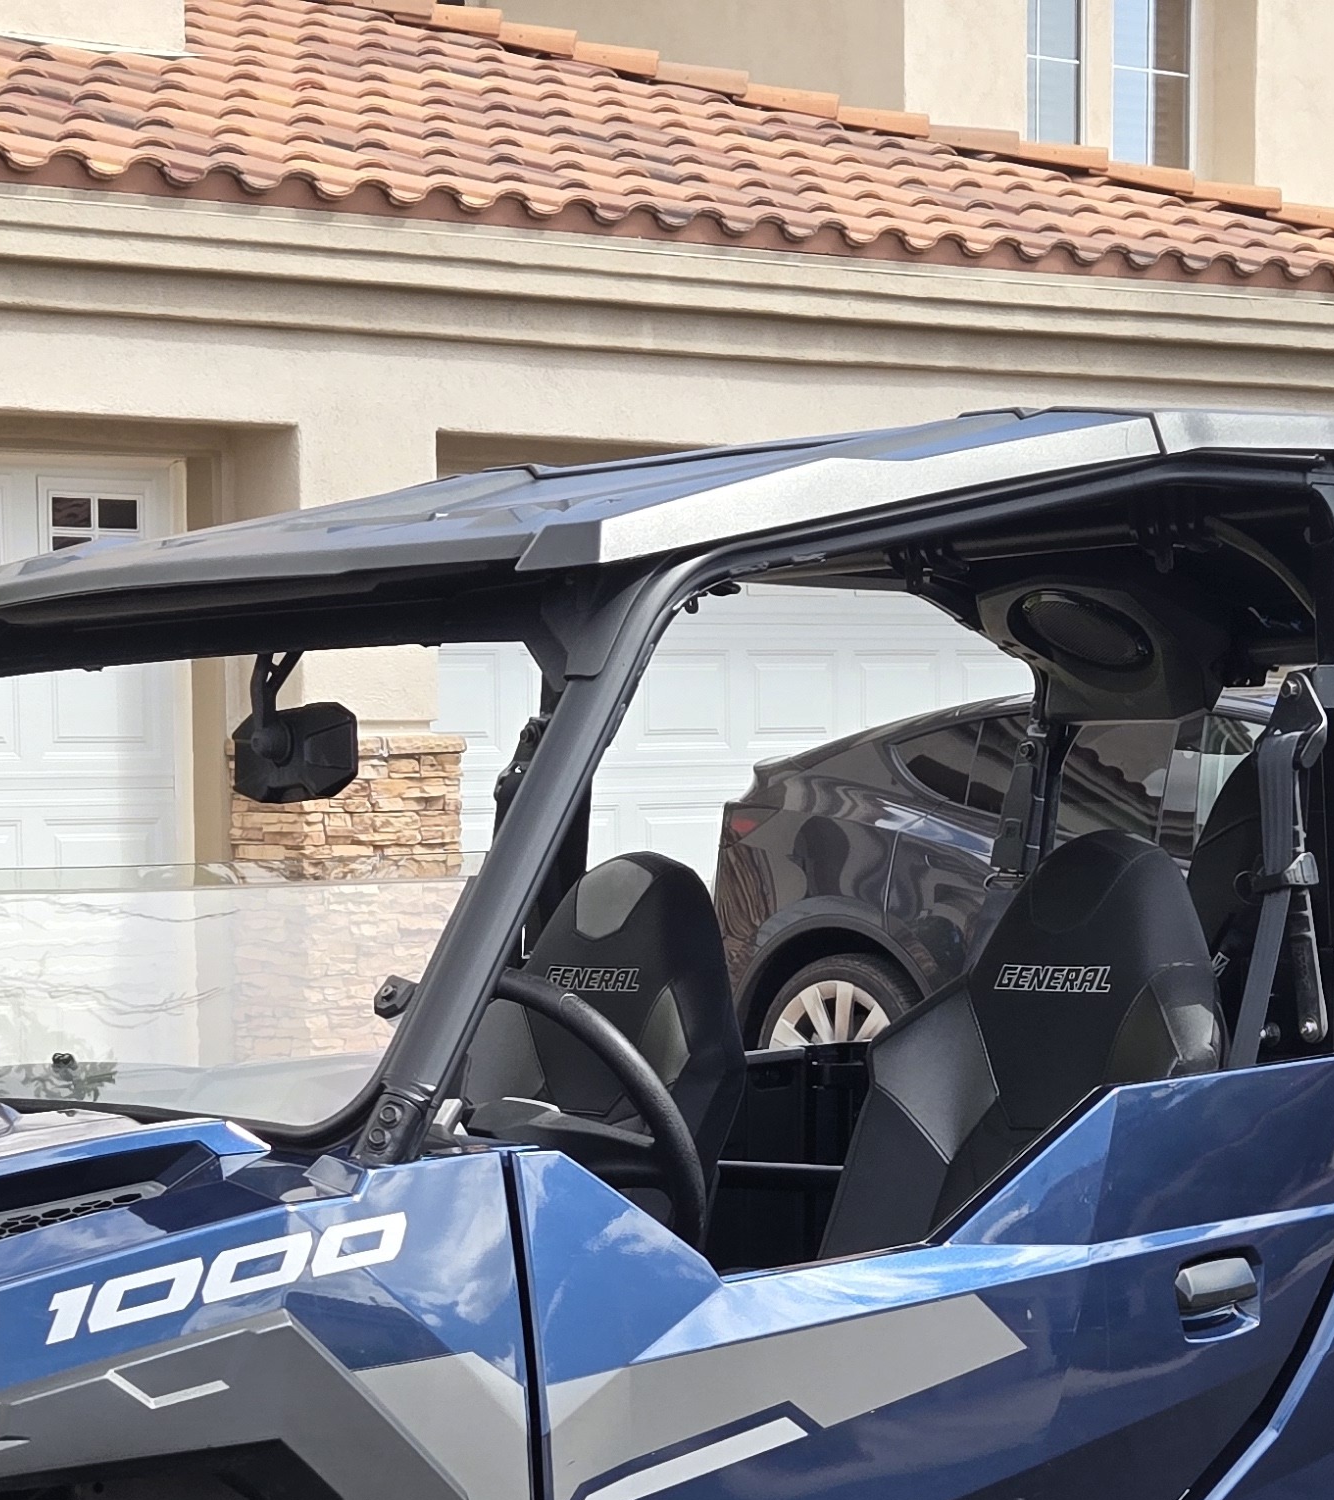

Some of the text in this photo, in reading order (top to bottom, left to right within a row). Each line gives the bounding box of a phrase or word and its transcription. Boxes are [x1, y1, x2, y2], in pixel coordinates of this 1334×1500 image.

[546, 966, 639, 992] GENERAL
[994, 964, 1110, 993] GENERAL
[45, 1212, 407, 1346] 1000
